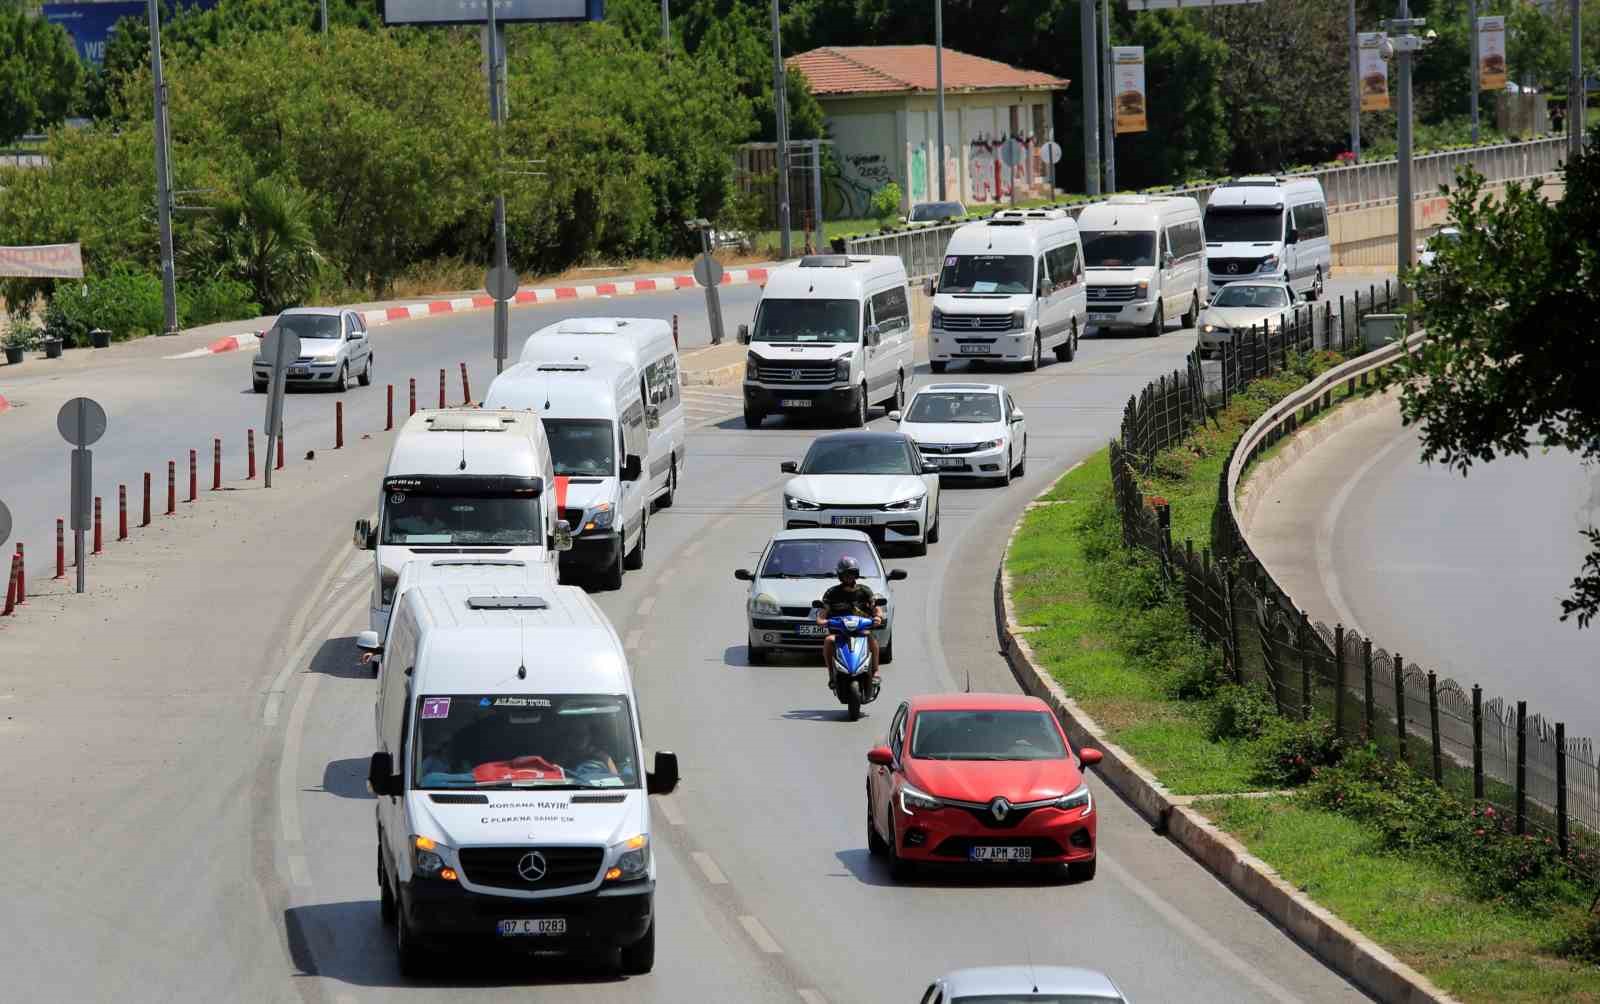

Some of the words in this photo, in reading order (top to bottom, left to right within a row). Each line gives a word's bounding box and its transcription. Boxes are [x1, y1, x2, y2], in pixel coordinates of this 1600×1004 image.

[976, 847, 986, 858] 07
[991, 847, 1008, 858] APM
[504, 920, 517, 932] 07
[524, 920, 532, 932] C
[538, 920, 565, 932] 0283
